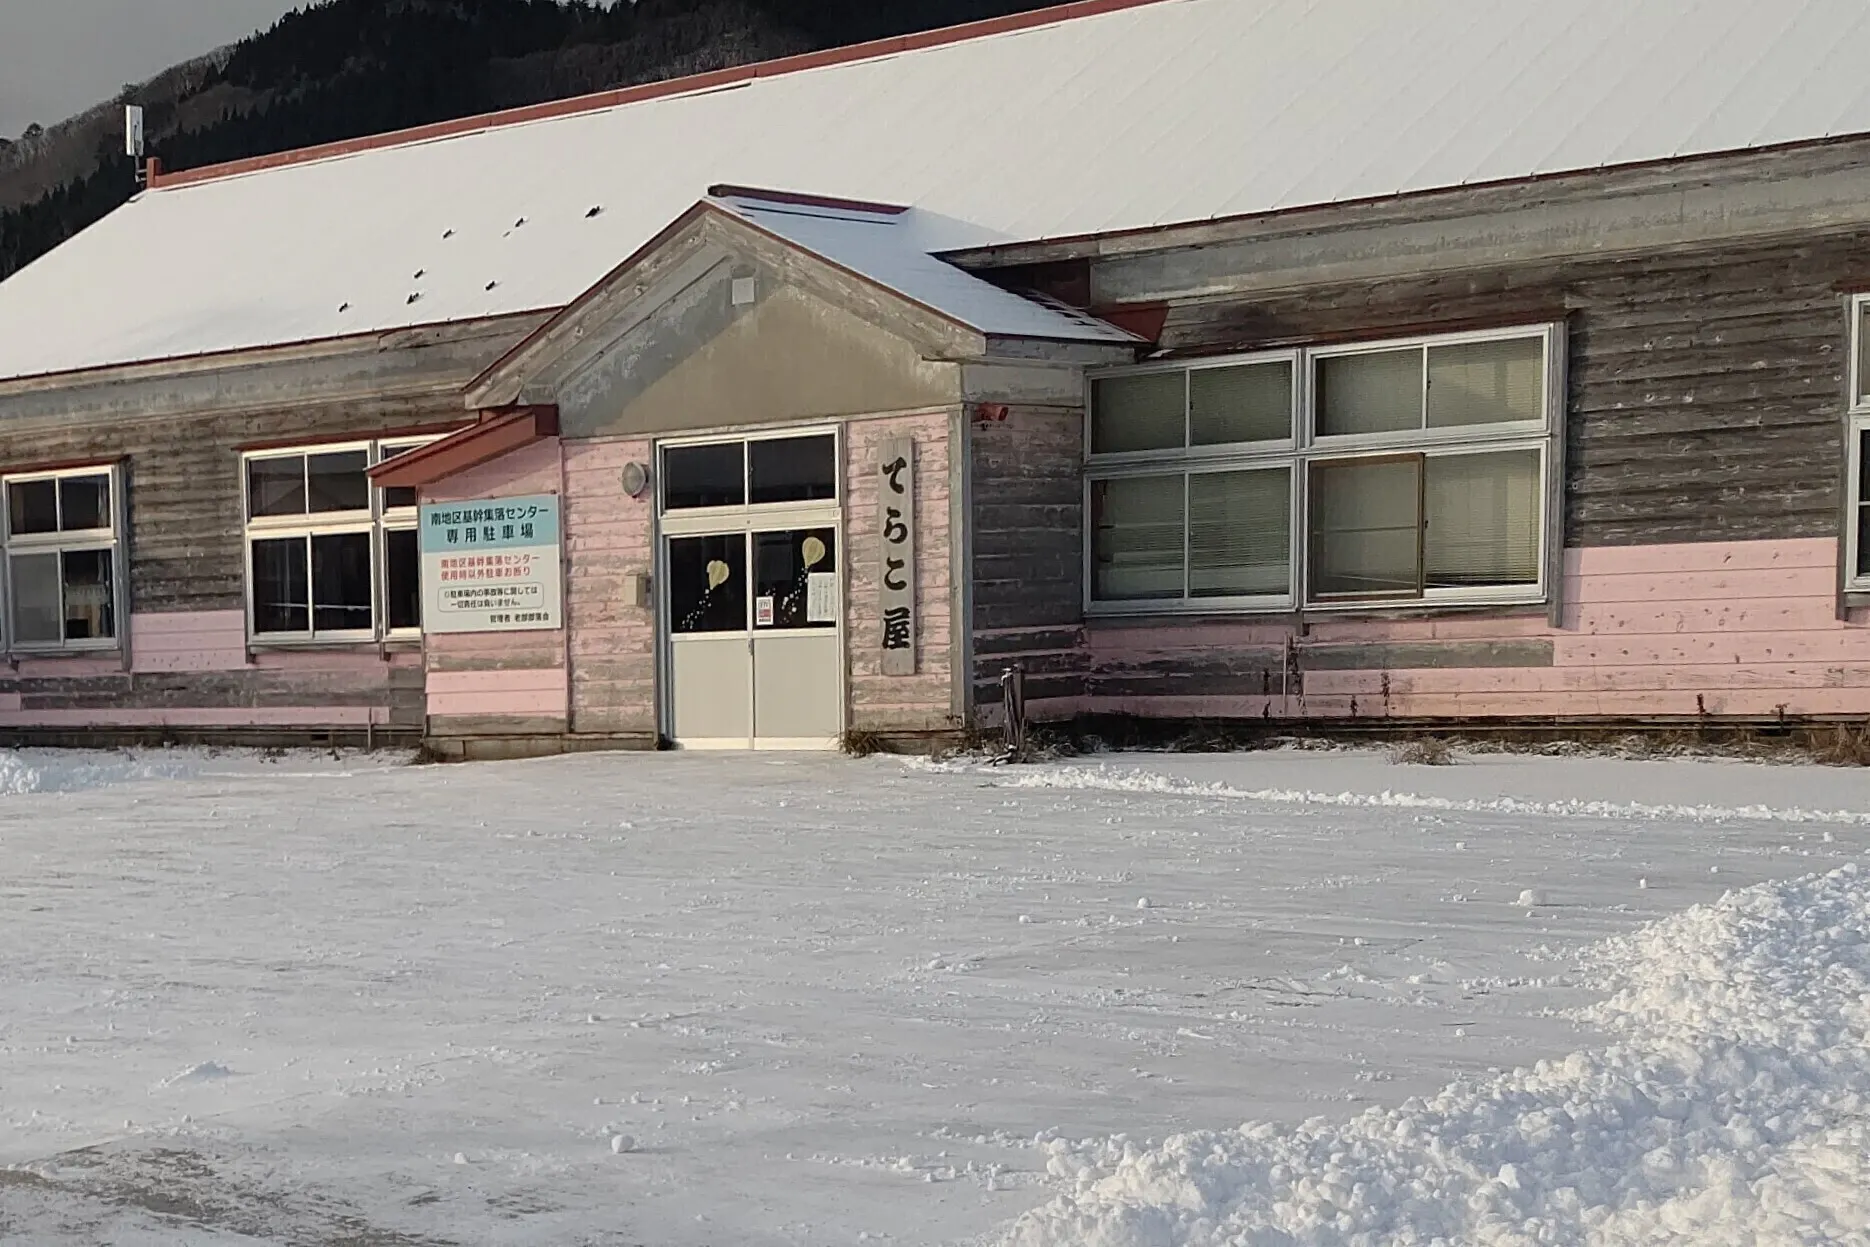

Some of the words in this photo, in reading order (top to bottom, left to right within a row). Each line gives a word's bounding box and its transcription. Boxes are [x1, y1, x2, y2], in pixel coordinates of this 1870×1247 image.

[431, 505, 549, 526] 南地区基幹集落センター
[447, 522, 534, 544] 専用駐車場
[441, 553, 541, 569] 南地区基幹集落センター
[882, 456, 910, 650] てらこ屋
[441, 566, 531, 581] 使用時以外駐車お断り
